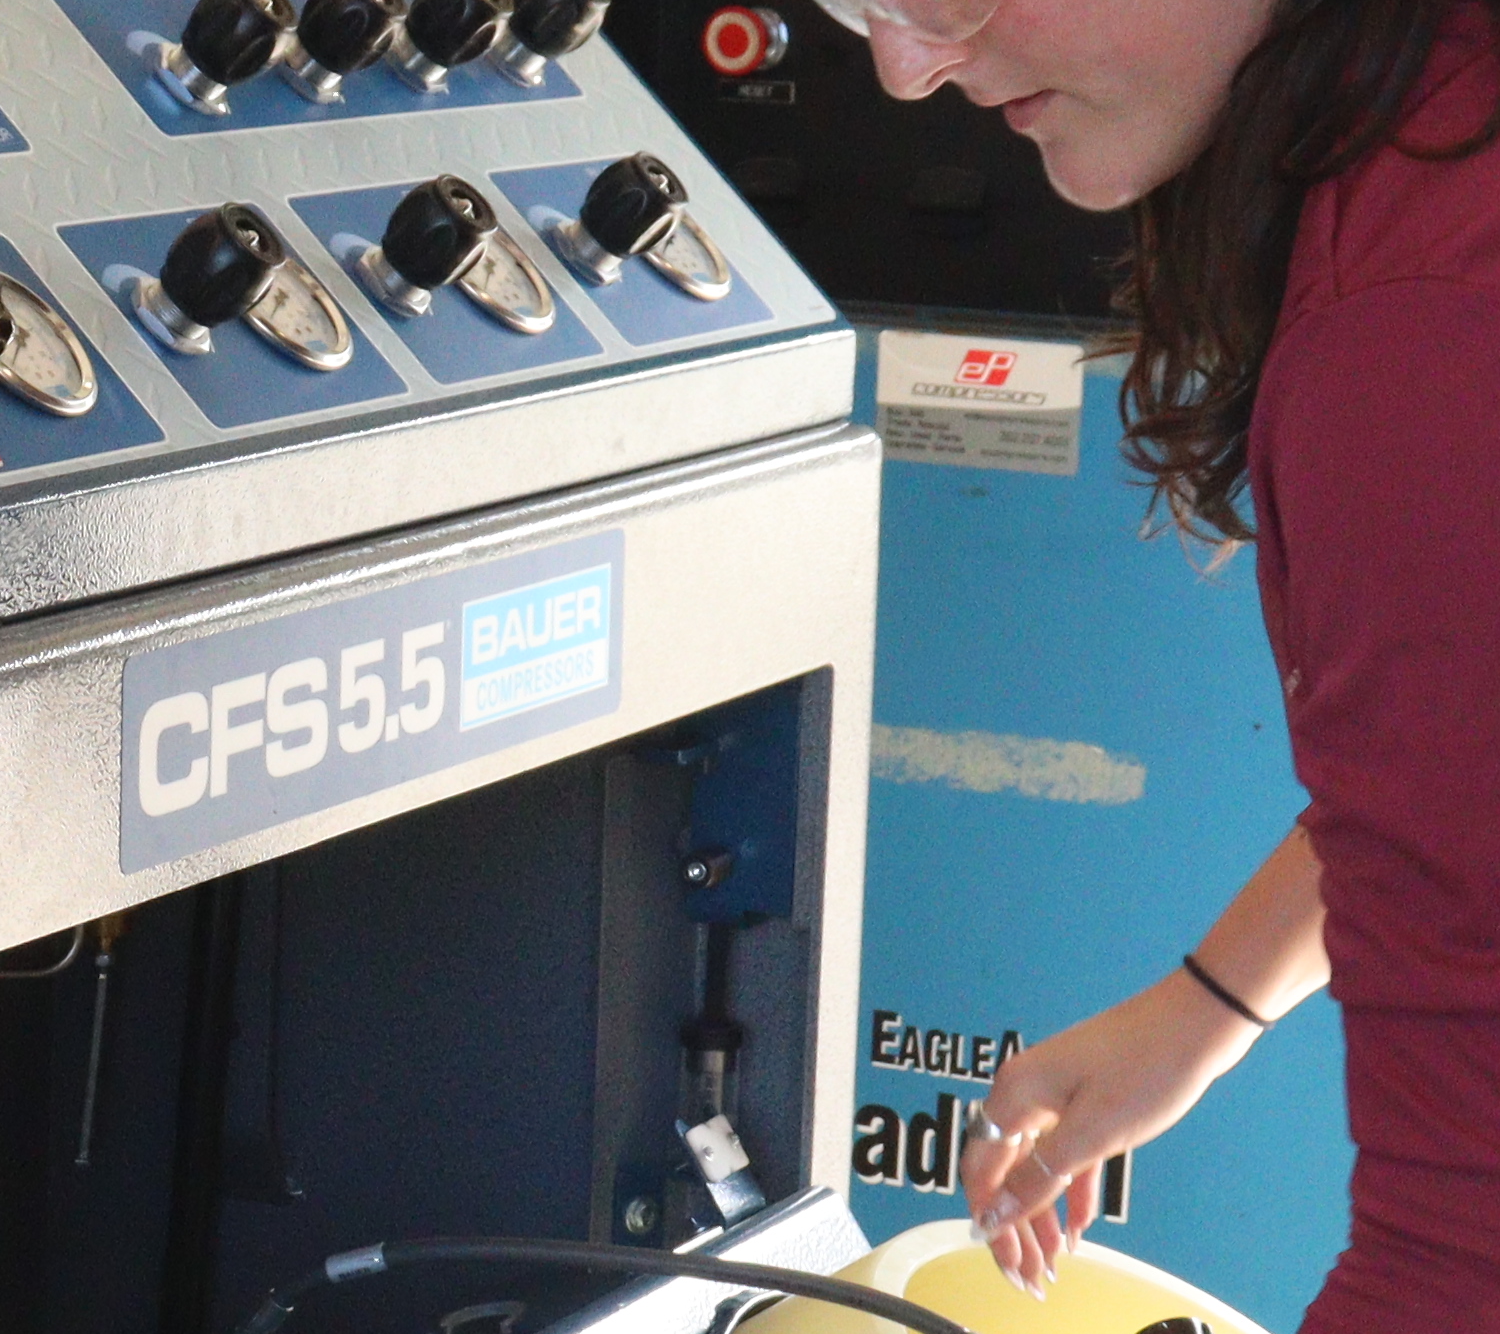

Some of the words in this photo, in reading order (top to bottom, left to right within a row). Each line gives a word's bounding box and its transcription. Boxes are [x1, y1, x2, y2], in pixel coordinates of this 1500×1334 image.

[470, 585, 604, 666] BAUER
[138, 656, 329, 817] CFS
[337, 621, 449, 755] 5.5
[476, 649, 596, 712] COMPRESSORS
